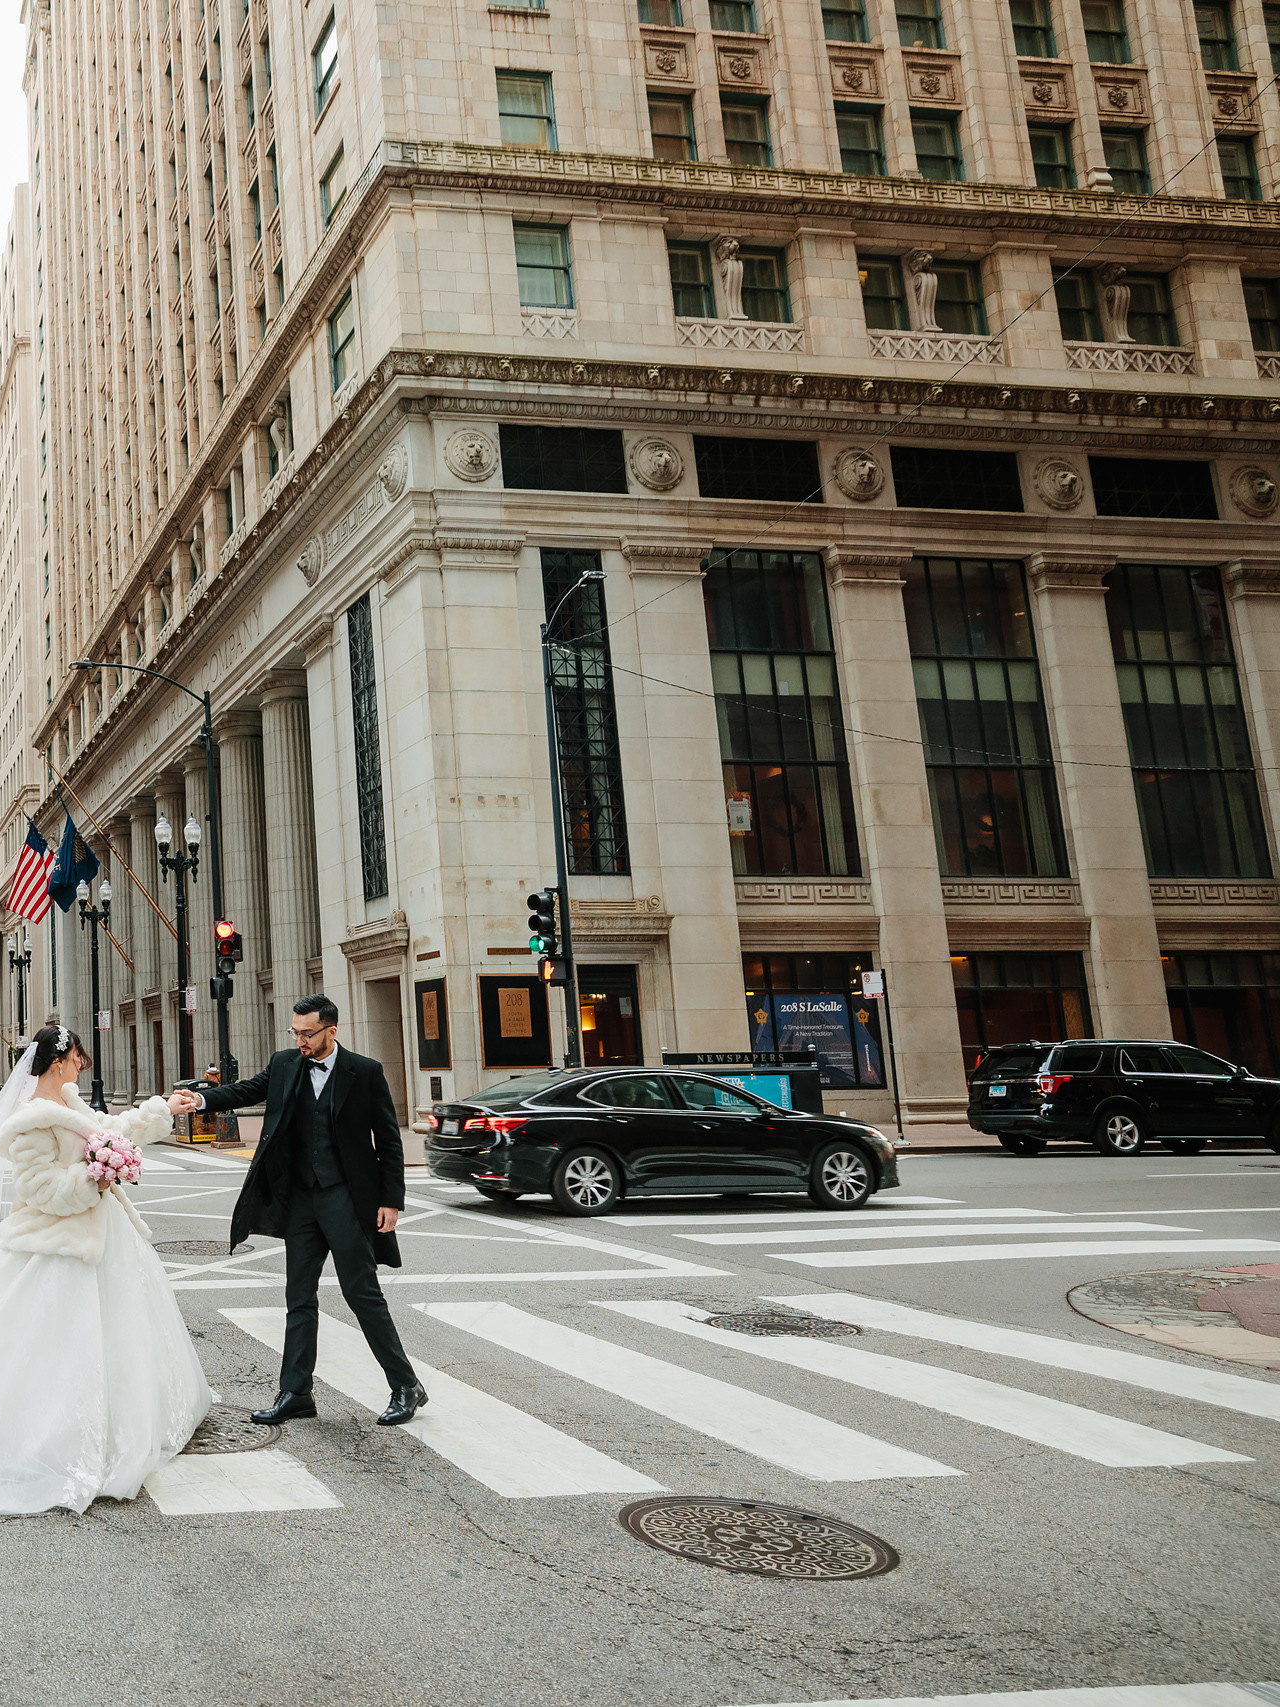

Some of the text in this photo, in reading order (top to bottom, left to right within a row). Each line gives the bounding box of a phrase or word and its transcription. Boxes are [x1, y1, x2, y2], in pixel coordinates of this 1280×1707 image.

[142, 718, 160, 757] AND
[165, 678, 194, 730] TRUST
[201, 600, 262, 691] COMPANY
[505, 993, 523, 1007] 208
[780, 1000, 843, 1013] 208 S LaSalle
[696, 1053, 785, 1063] NEWSPAPERS
